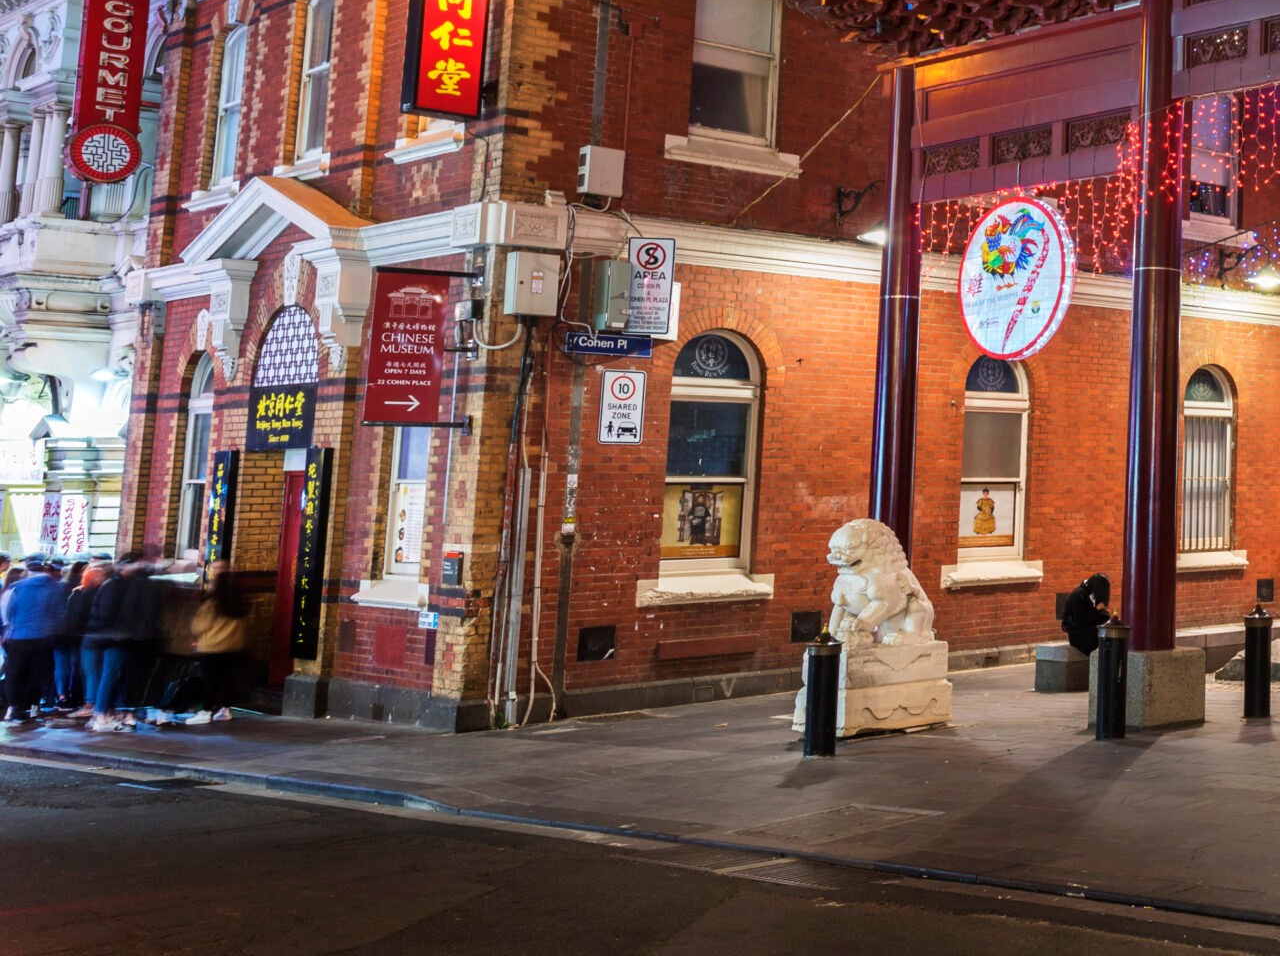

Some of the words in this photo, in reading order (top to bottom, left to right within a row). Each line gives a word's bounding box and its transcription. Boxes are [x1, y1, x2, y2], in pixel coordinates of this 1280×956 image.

[95, 0, 135, 123] GOURMET
[634, 270, 667, 281] AREA
[381, 331, 436, 344] CHINESE
[579, 336, 615, 349] Cohen
[617, 339, 628, 350] Pl
[380, 344, 435, 356] MUSEUM
[618, 383, 630, 395] 10
[607, 402, 638, 411] SHARED
[611, 411, 632, 420] ZONE
[76, 501, 89, 553] VILLAGE
